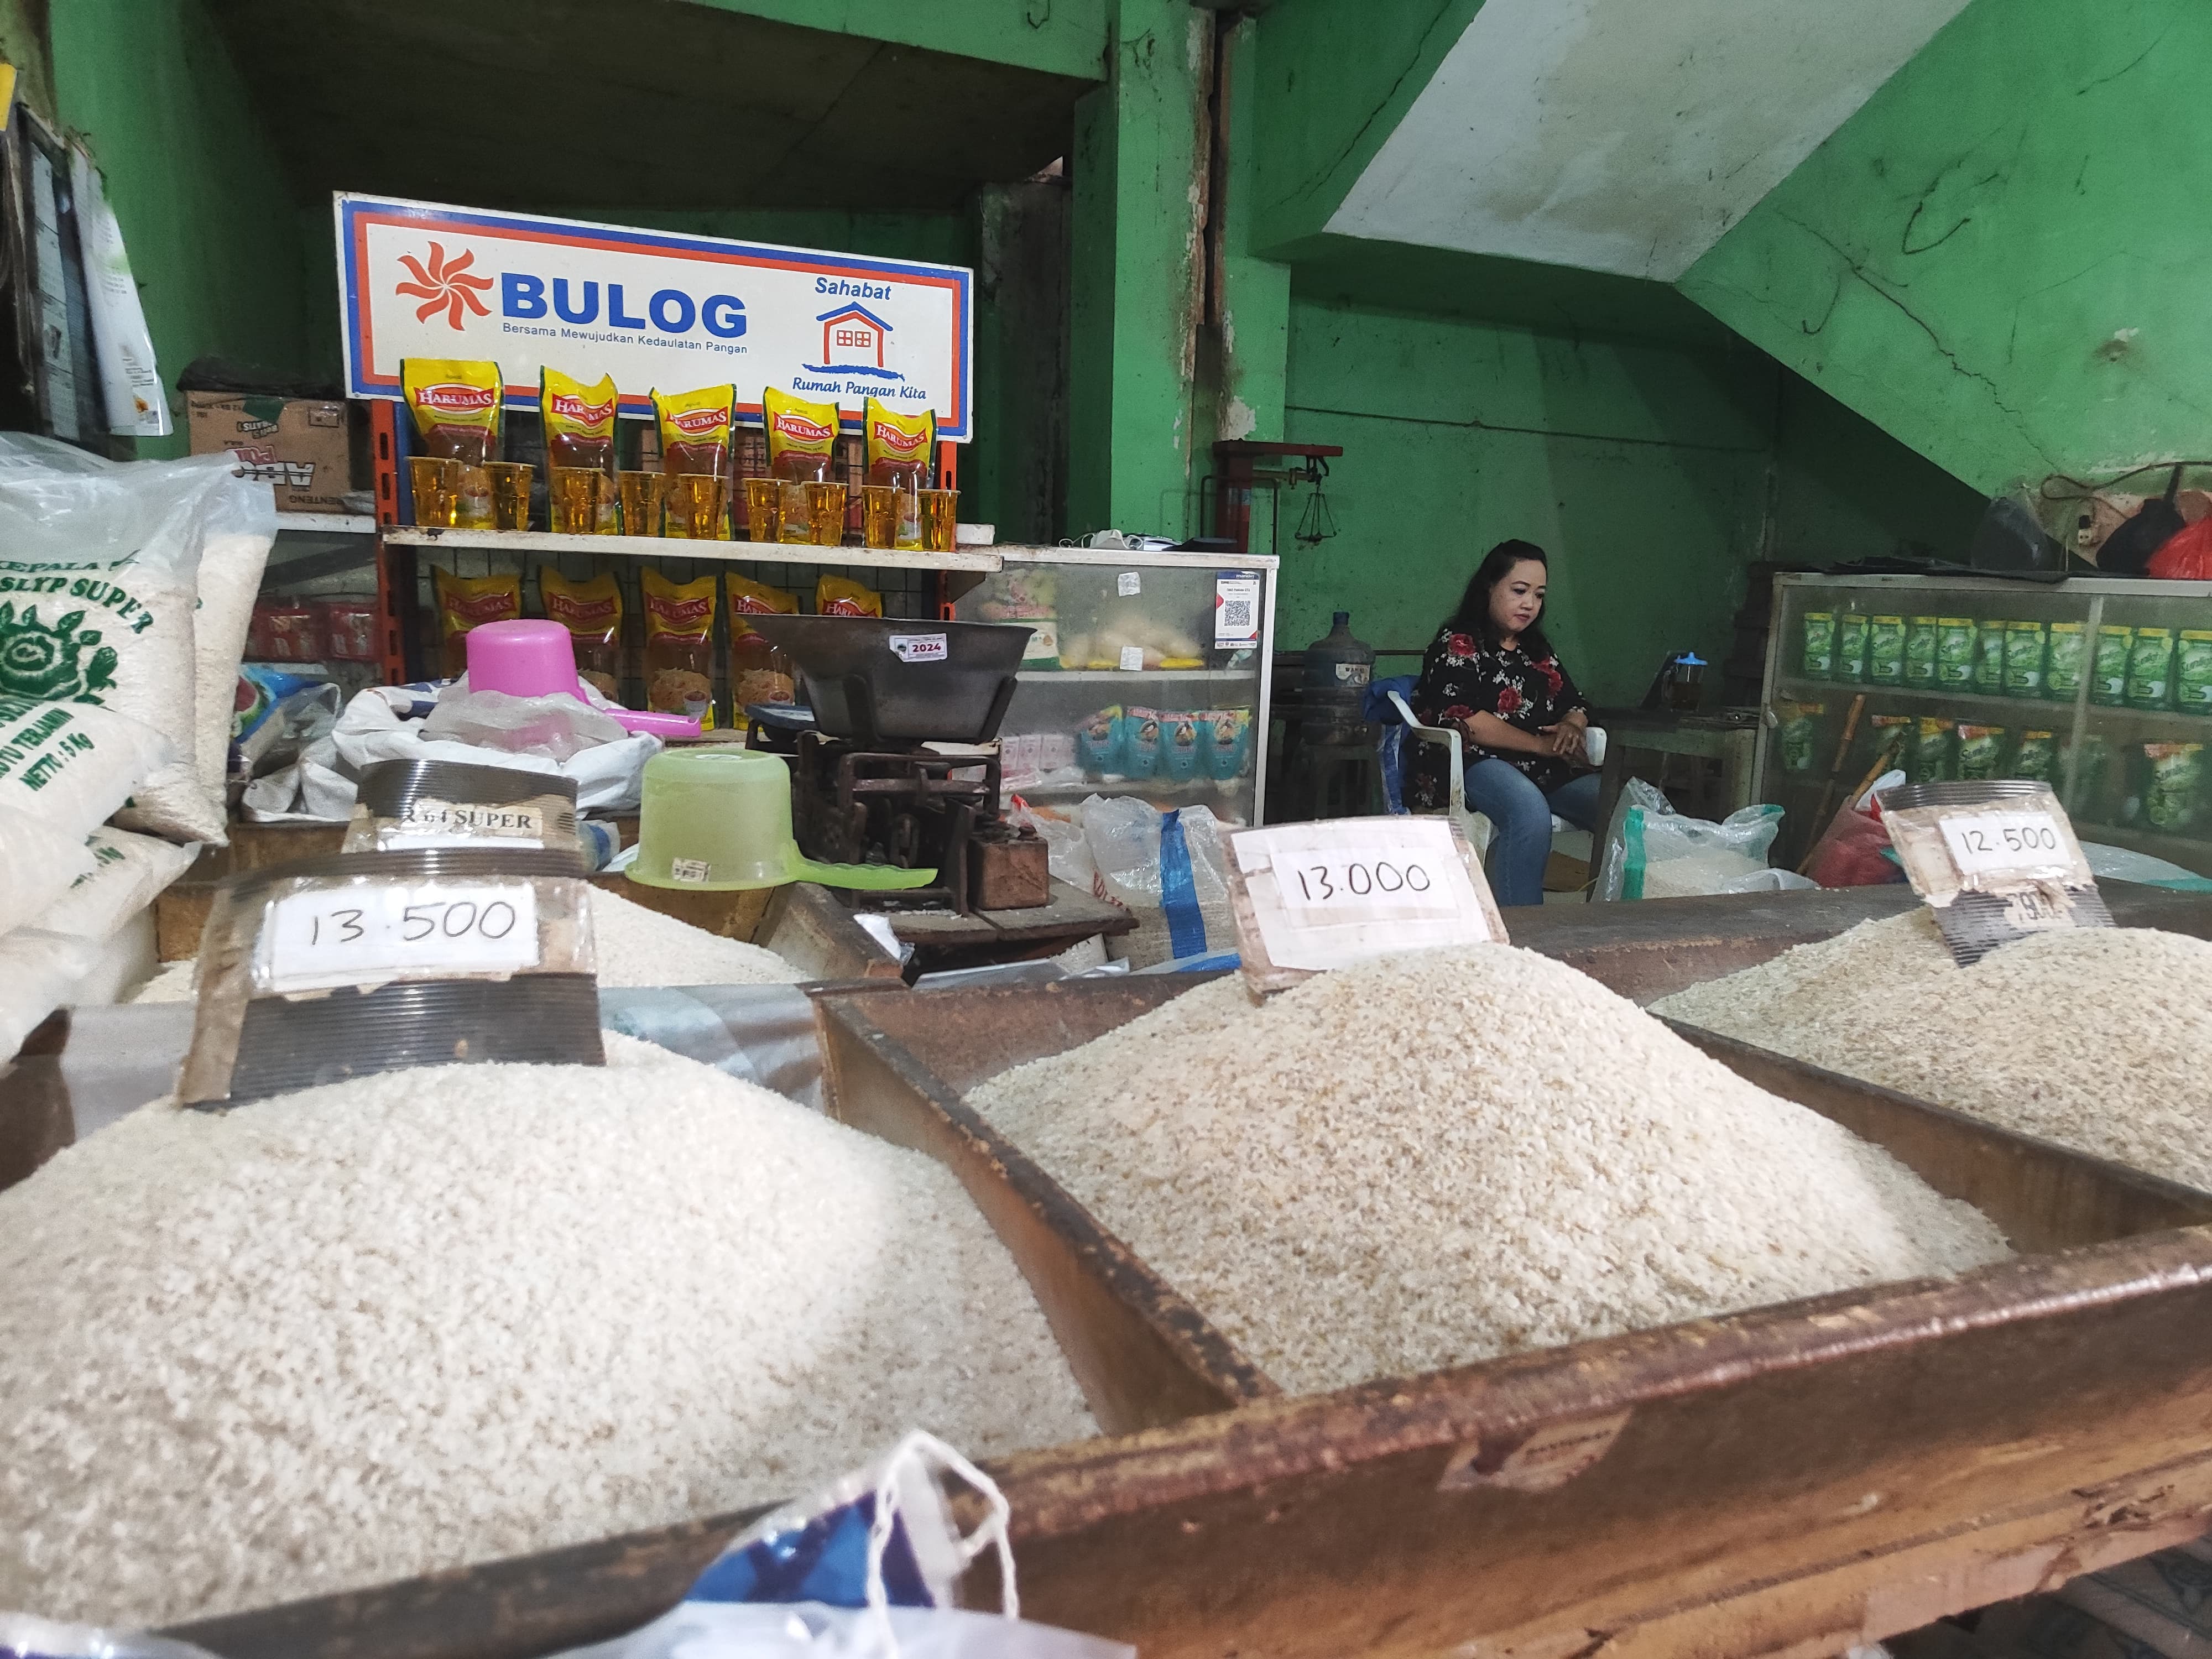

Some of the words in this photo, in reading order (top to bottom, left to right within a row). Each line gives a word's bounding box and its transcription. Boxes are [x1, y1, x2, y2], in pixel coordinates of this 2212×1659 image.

[815, 277, 891, 300] Sahabat
[501, 272, 747, 338] BULOG
[503, 322, 556, 338] Bersama
[561, 327, 634, 345] Mewujudkan
[638, 335, 702, 351] Kedaulatan
[706, 341, 748, 355] Pangan
[419, 392, 492, 405] HARUMAS
[792, 377, 842, 394] Rumah
[846, 383, 896, 398] Pangan
[899, 385, 927, 400] Kita
[555, 399, 613, 421] HARMAS
[777, 416, 831, 437] HARUMAS
[876, 424, 925, 447] HARUMAS
[0, 560, 101, 573] EPALA
[70, 578, 154, 634] SUPER
[912, 643, 942, 653] 2024
[11, 708, 75, 750] TERJAMIN
[58, 740, 77, 758] 5
[66, 733, 95, 751] Kg
[19, 753, 65, 791] NETTO
[455, 809, 532, 828] SUPER
[1961, 826, 2057, 855] 12.500
[1297, 861, 1431, 901] 13.000
[311, 900, 517, 946] 13.500
